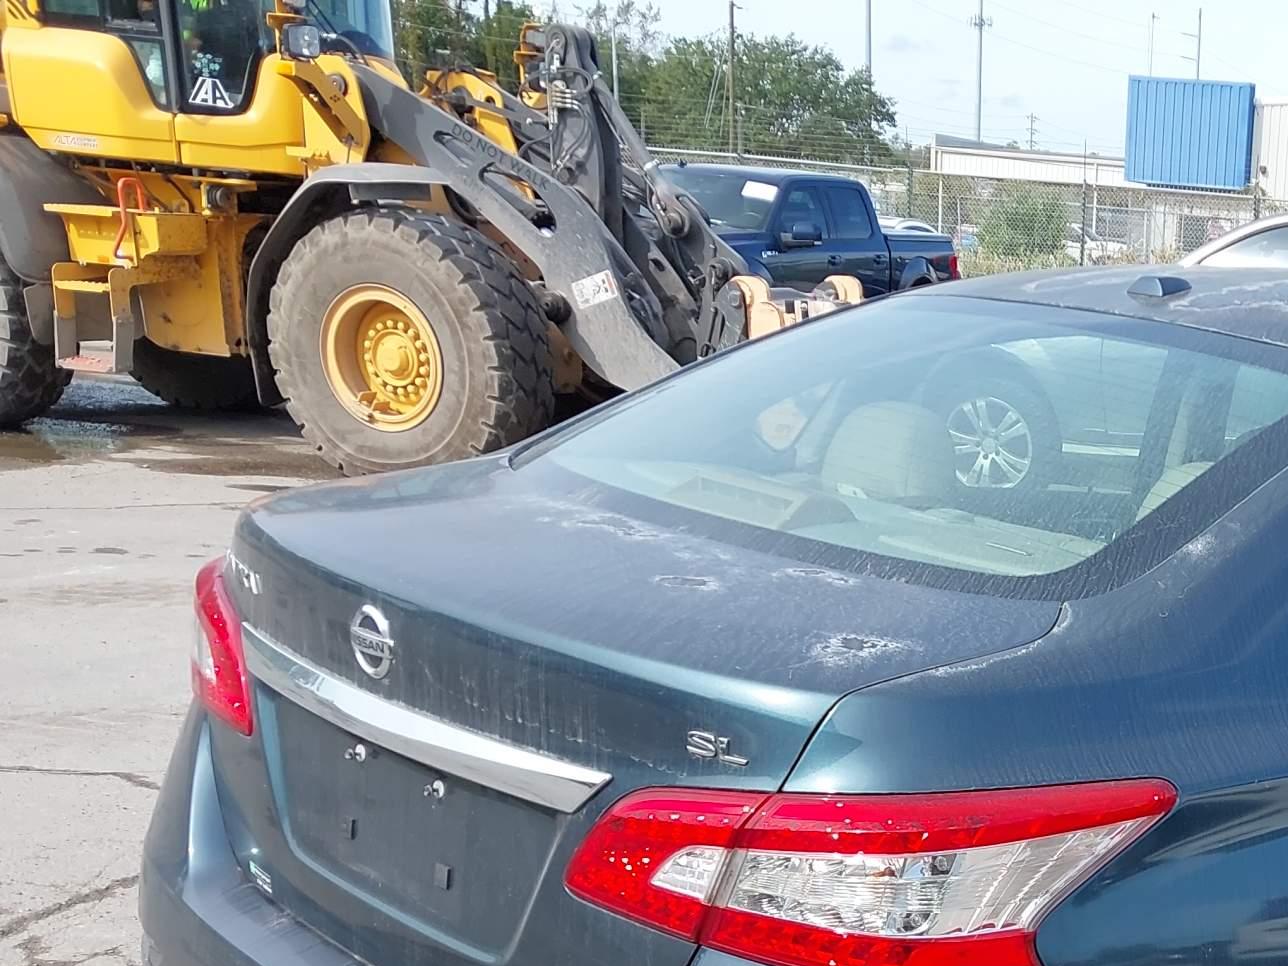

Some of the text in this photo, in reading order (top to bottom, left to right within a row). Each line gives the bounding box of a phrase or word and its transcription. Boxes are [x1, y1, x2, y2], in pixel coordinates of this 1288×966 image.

[452, 123, 473, 142] DO
[476, 139, 507, 162] NOT
[511, 157, 549, 190] WALK
[685, 730, 750, 767] SL
